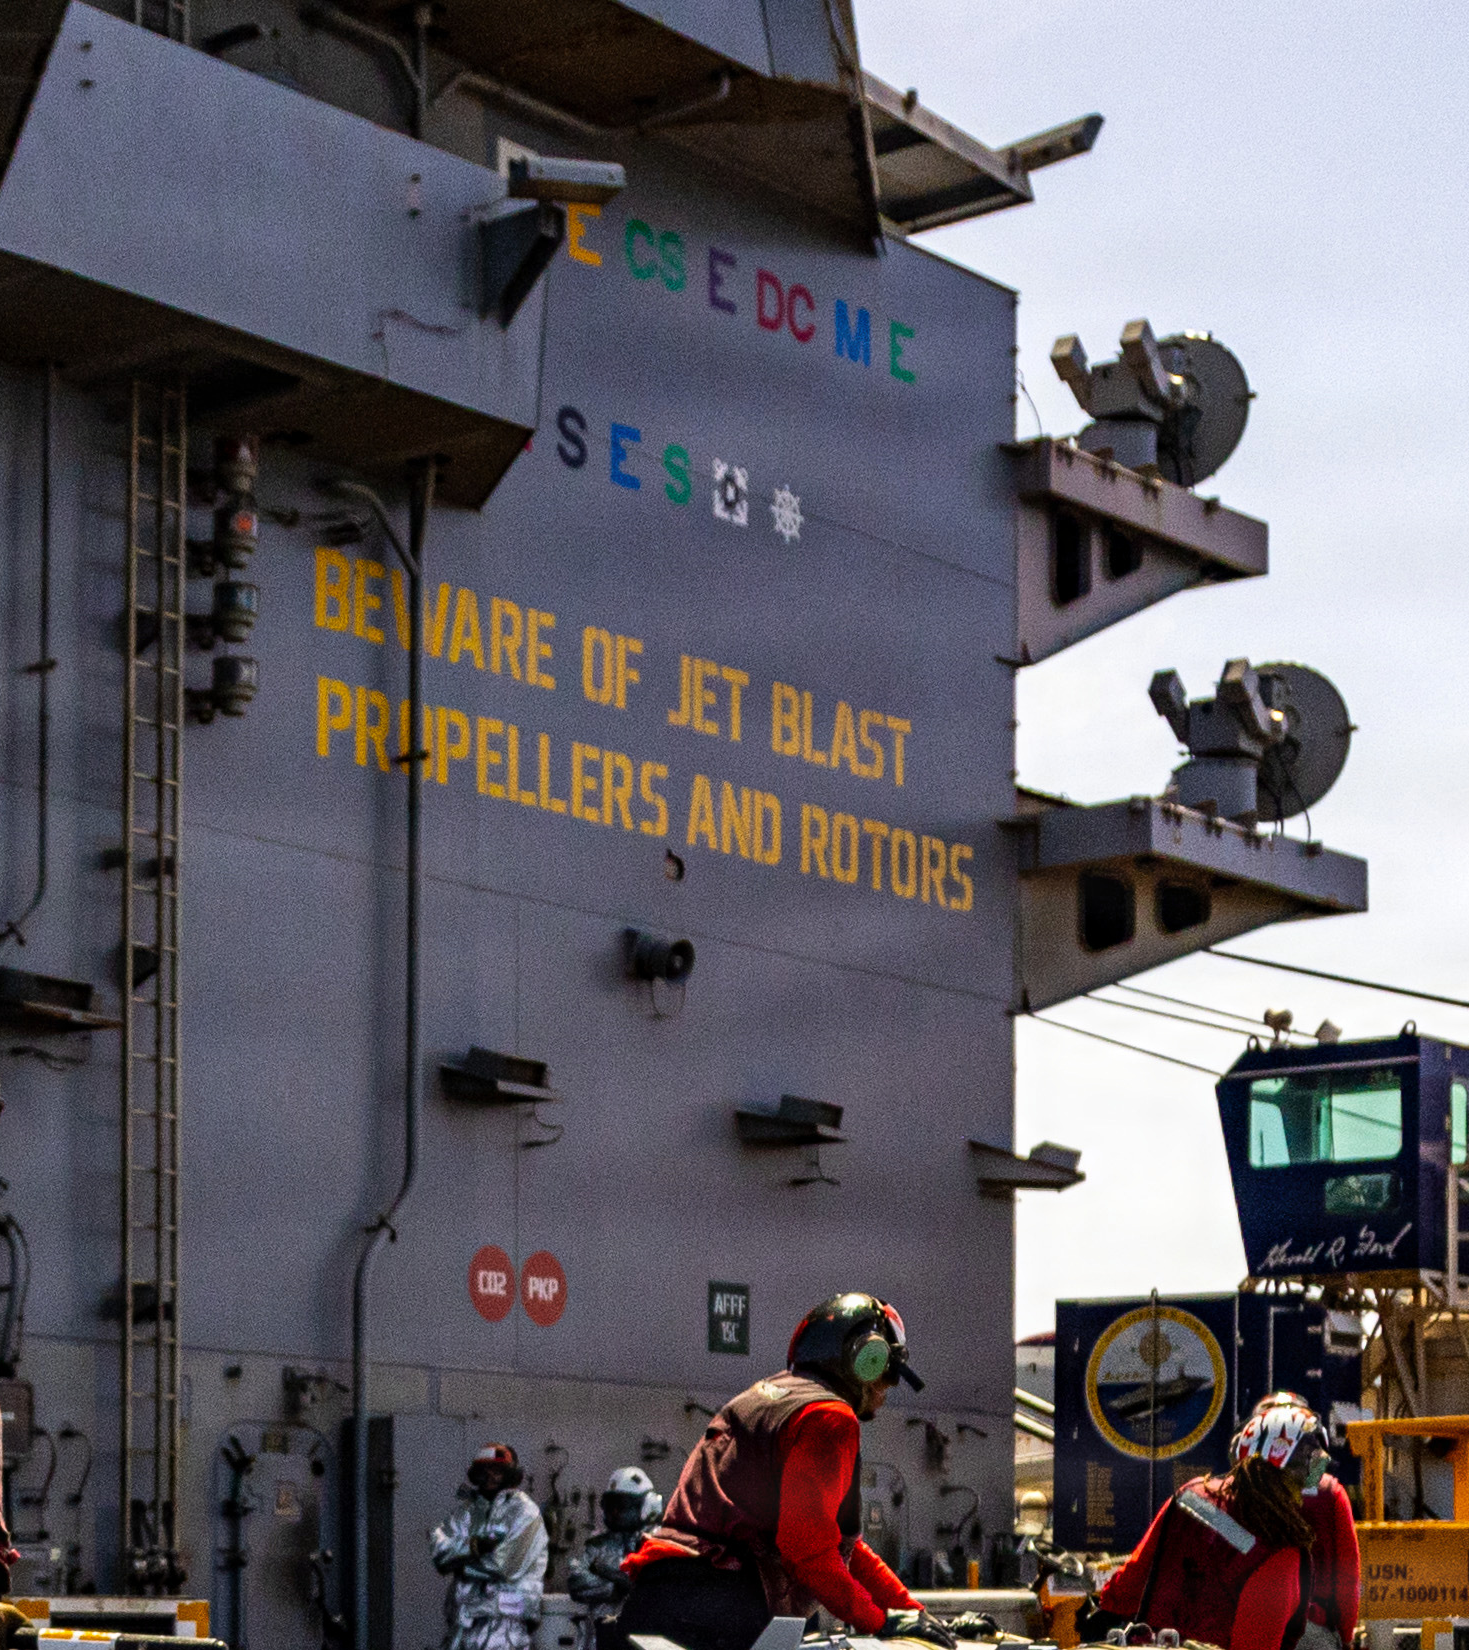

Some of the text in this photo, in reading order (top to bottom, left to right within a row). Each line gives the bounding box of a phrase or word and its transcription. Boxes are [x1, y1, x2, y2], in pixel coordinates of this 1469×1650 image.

[709, 246, 737, 315] E
[757, 269, 815, 342] DC
[835, 300, 871, 367] M
[890, 320, 916, 384] E
[557, 406, 692, 504] S E S
[314, 547, 911, 787] BEWARE OF JET BLAST
[315, 675, 974, 911] PROPELLERS AND ROTORS
[527, 1275, 559, 1302] PKP
[713, 1292, 747, 1318] AFFF
